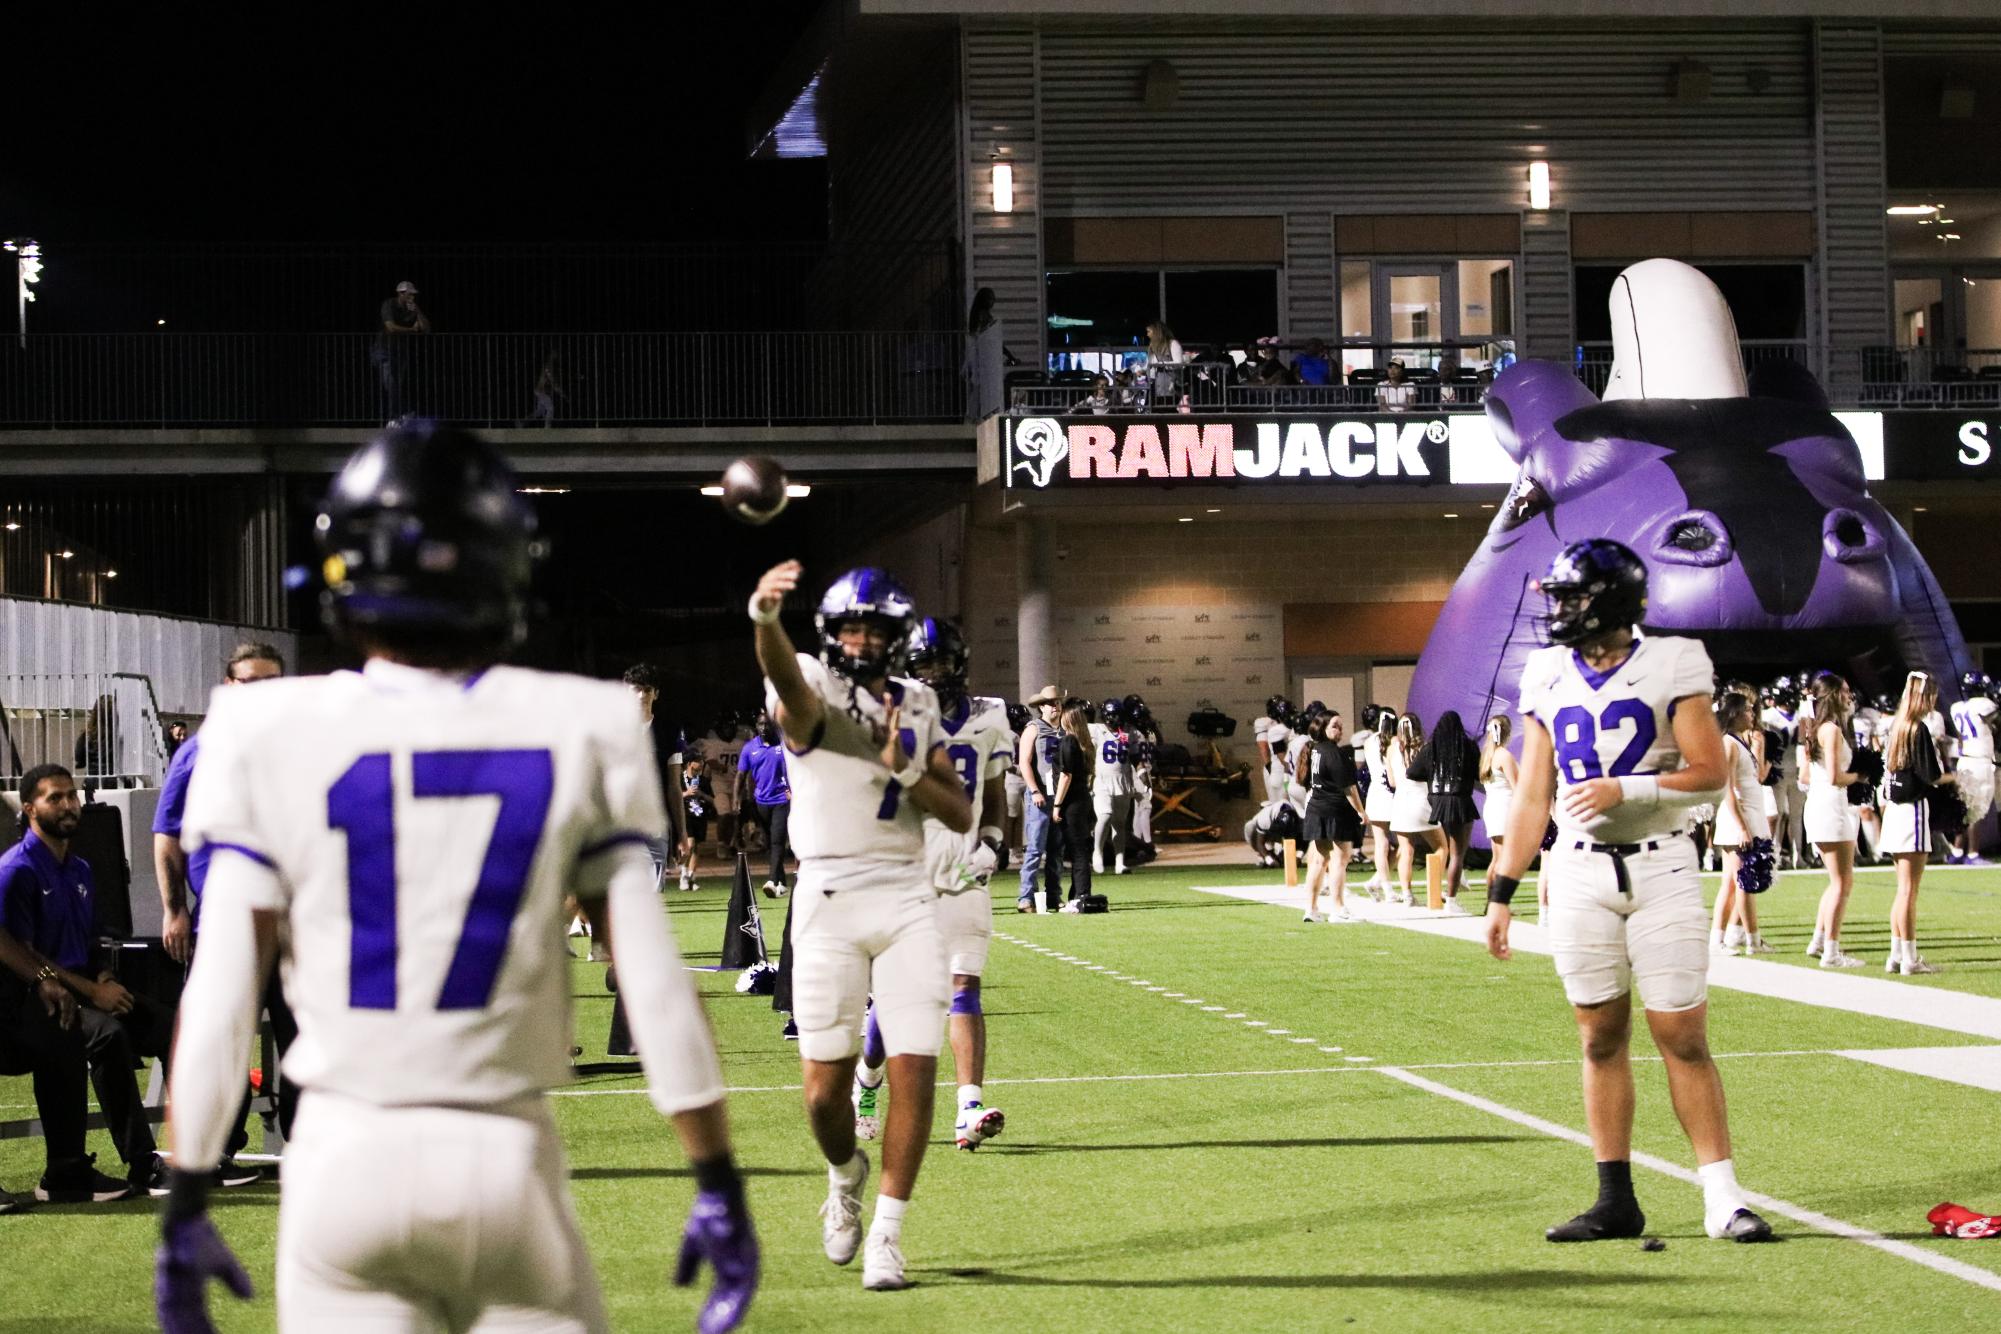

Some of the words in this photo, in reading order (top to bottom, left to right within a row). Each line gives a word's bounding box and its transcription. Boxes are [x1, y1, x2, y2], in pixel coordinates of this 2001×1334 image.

[1553, 698, 1660, 785] 82
[1955, 712, 1978, 741] 21
[327, 748, 554, 1009] 17
